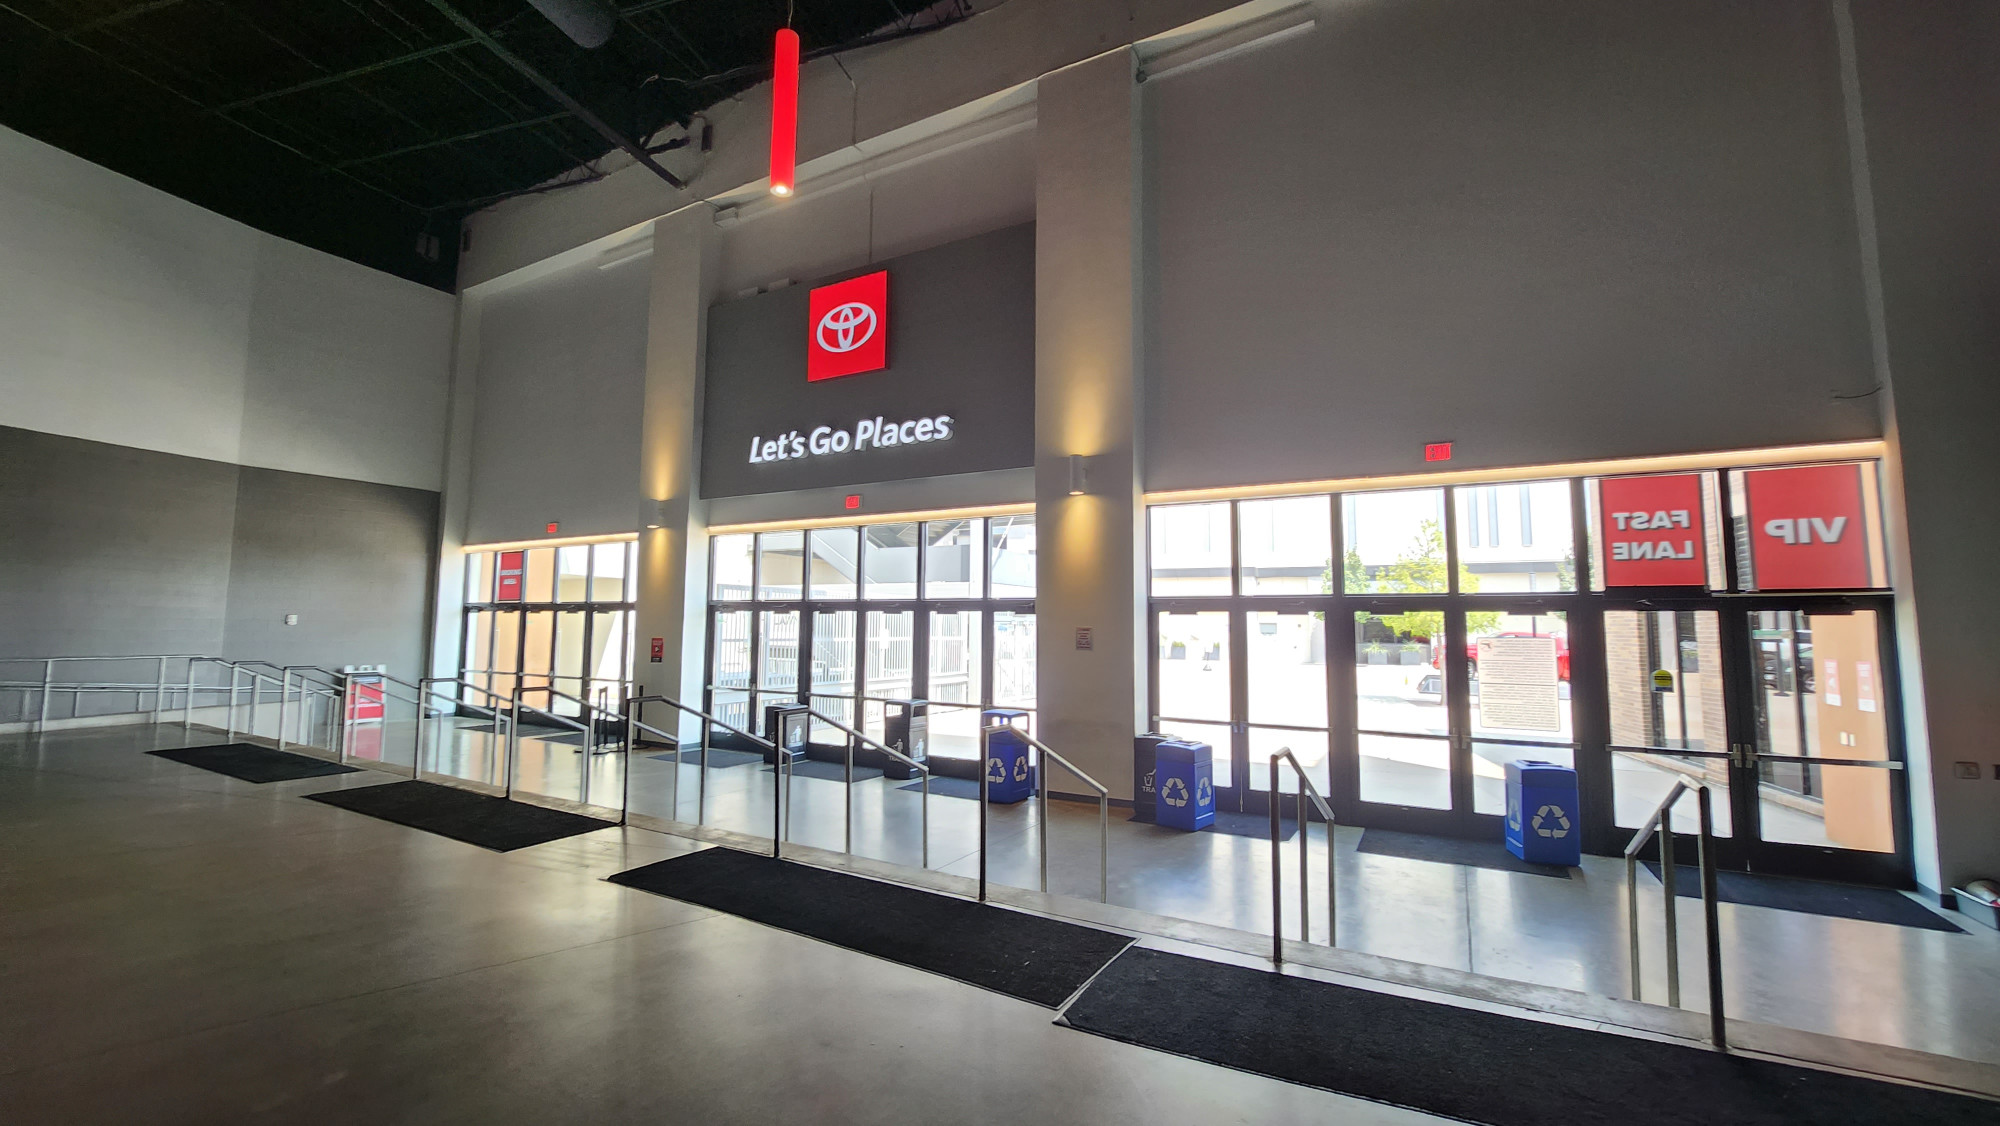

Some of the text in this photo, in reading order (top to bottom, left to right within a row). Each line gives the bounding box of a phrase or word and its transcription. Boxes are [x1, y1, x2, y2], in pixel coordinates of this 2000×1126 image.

[749, 415, 951, 463] Let's Go Places
[1141, 785, 1156, 793] TRA
